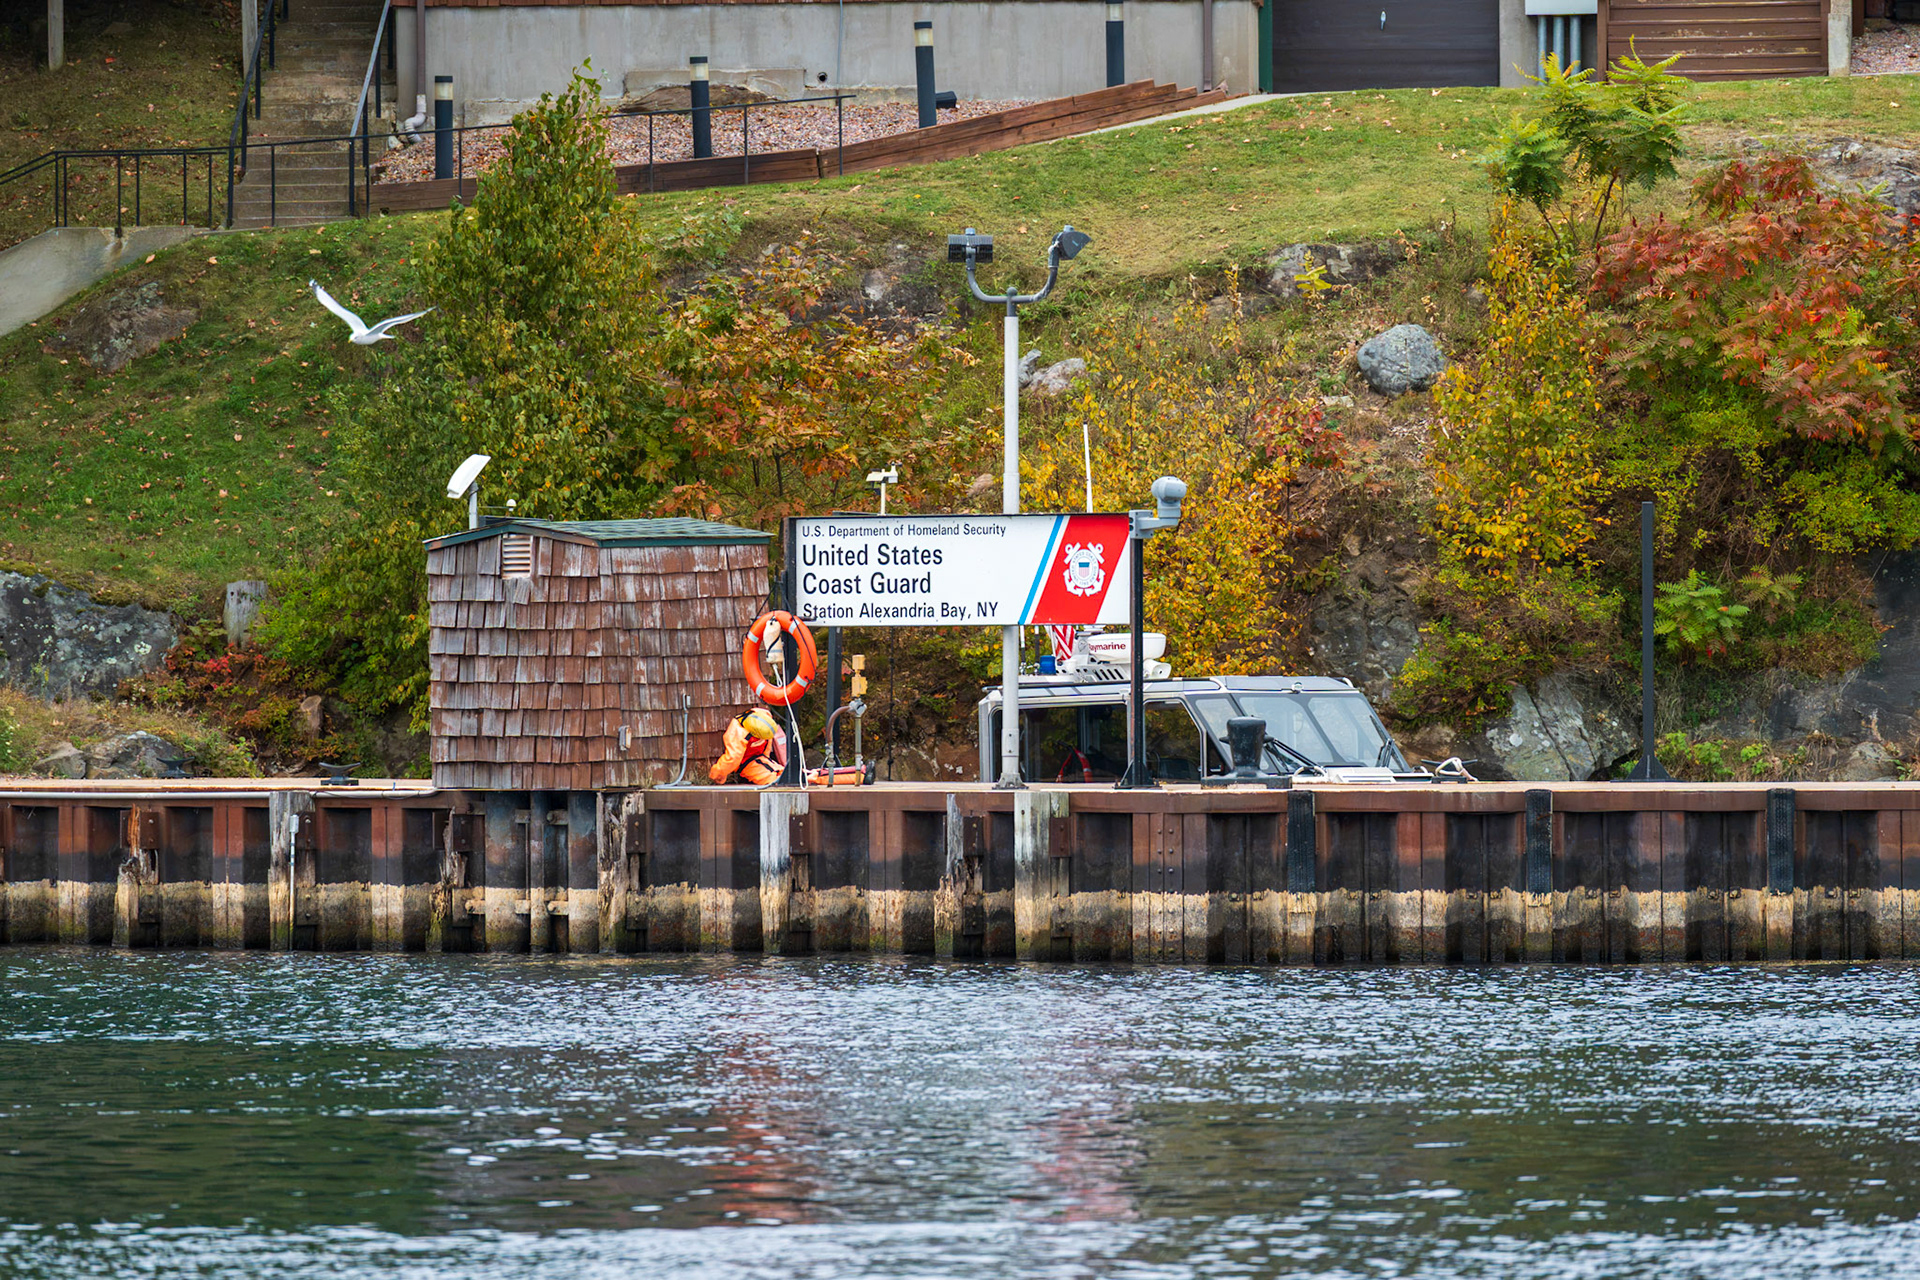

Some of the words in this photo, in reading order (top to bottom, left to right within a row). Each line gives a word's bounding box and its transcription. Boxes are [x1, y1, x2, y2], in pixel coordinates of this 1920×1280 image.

[802, 525, 825, 538] U.S.
[828, 525, 890, 539] Department
[893, 524, 904, 536] of
[907, 523, 960, 536] Homeland
[963, 523, 1006, 537] Security
[802, 543, 868, 567] United
[877, 543, 943, 566] States
[803, 572, 861, 595] Coast
[870, 571, 931, 594] Guard
[803, 603, 854, 619] Station
[859, 602, 935, 618] Alexandria
[940, 602, 971, 621] Bay,
[977, 601, 999, 617] NY
